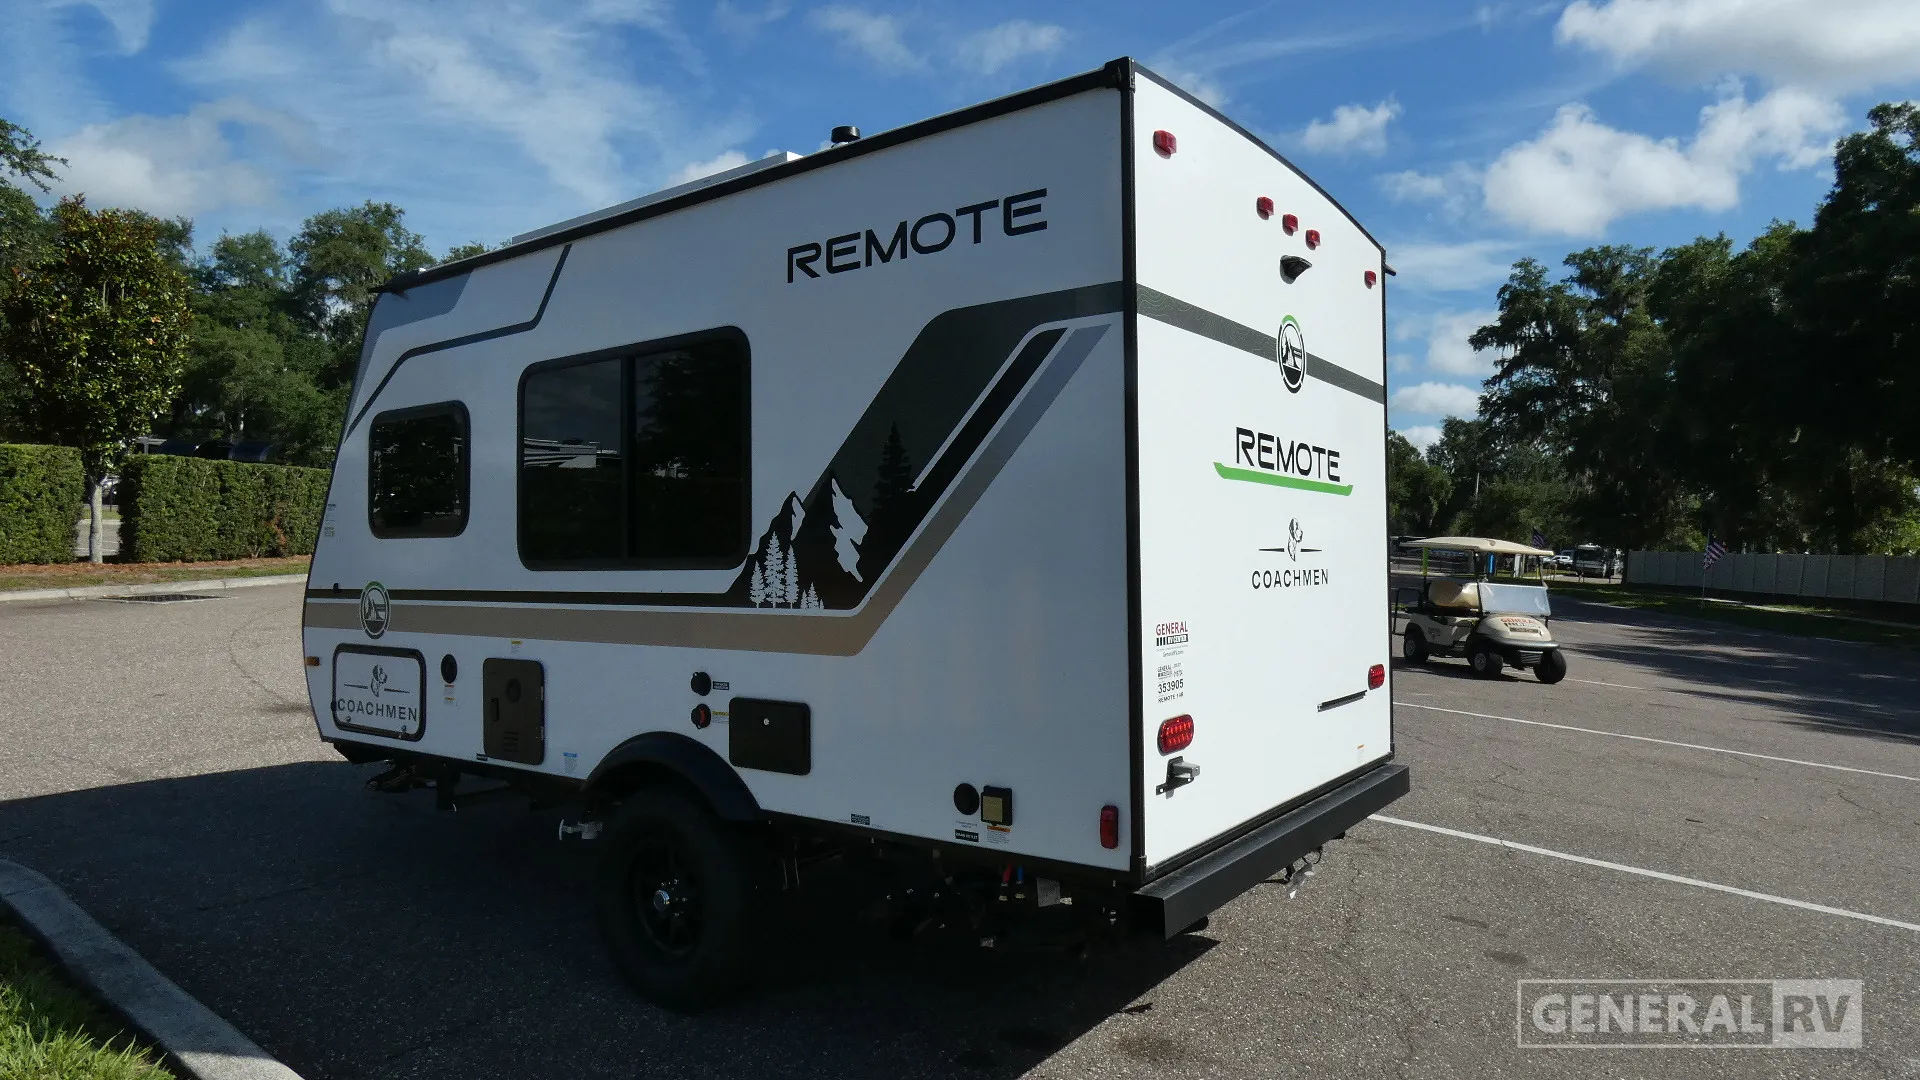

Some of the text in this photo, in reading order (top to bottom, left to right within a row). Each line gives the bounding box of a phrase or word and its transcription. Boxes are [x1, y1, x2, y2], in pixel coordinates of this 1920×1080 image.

[787, 188, 1048, 283] REMOTE
[1235, 426, 1341, 482] REMOTE
[1251, 568, 1329, 589] COACHMEN
[1156, 621, 1188, 636] GENERAL
[1158, 678, 1184, 694] 353905
[1158, 694, 1176, 703] REMOTE
[337, 698, 417, 722] COACHMEN
